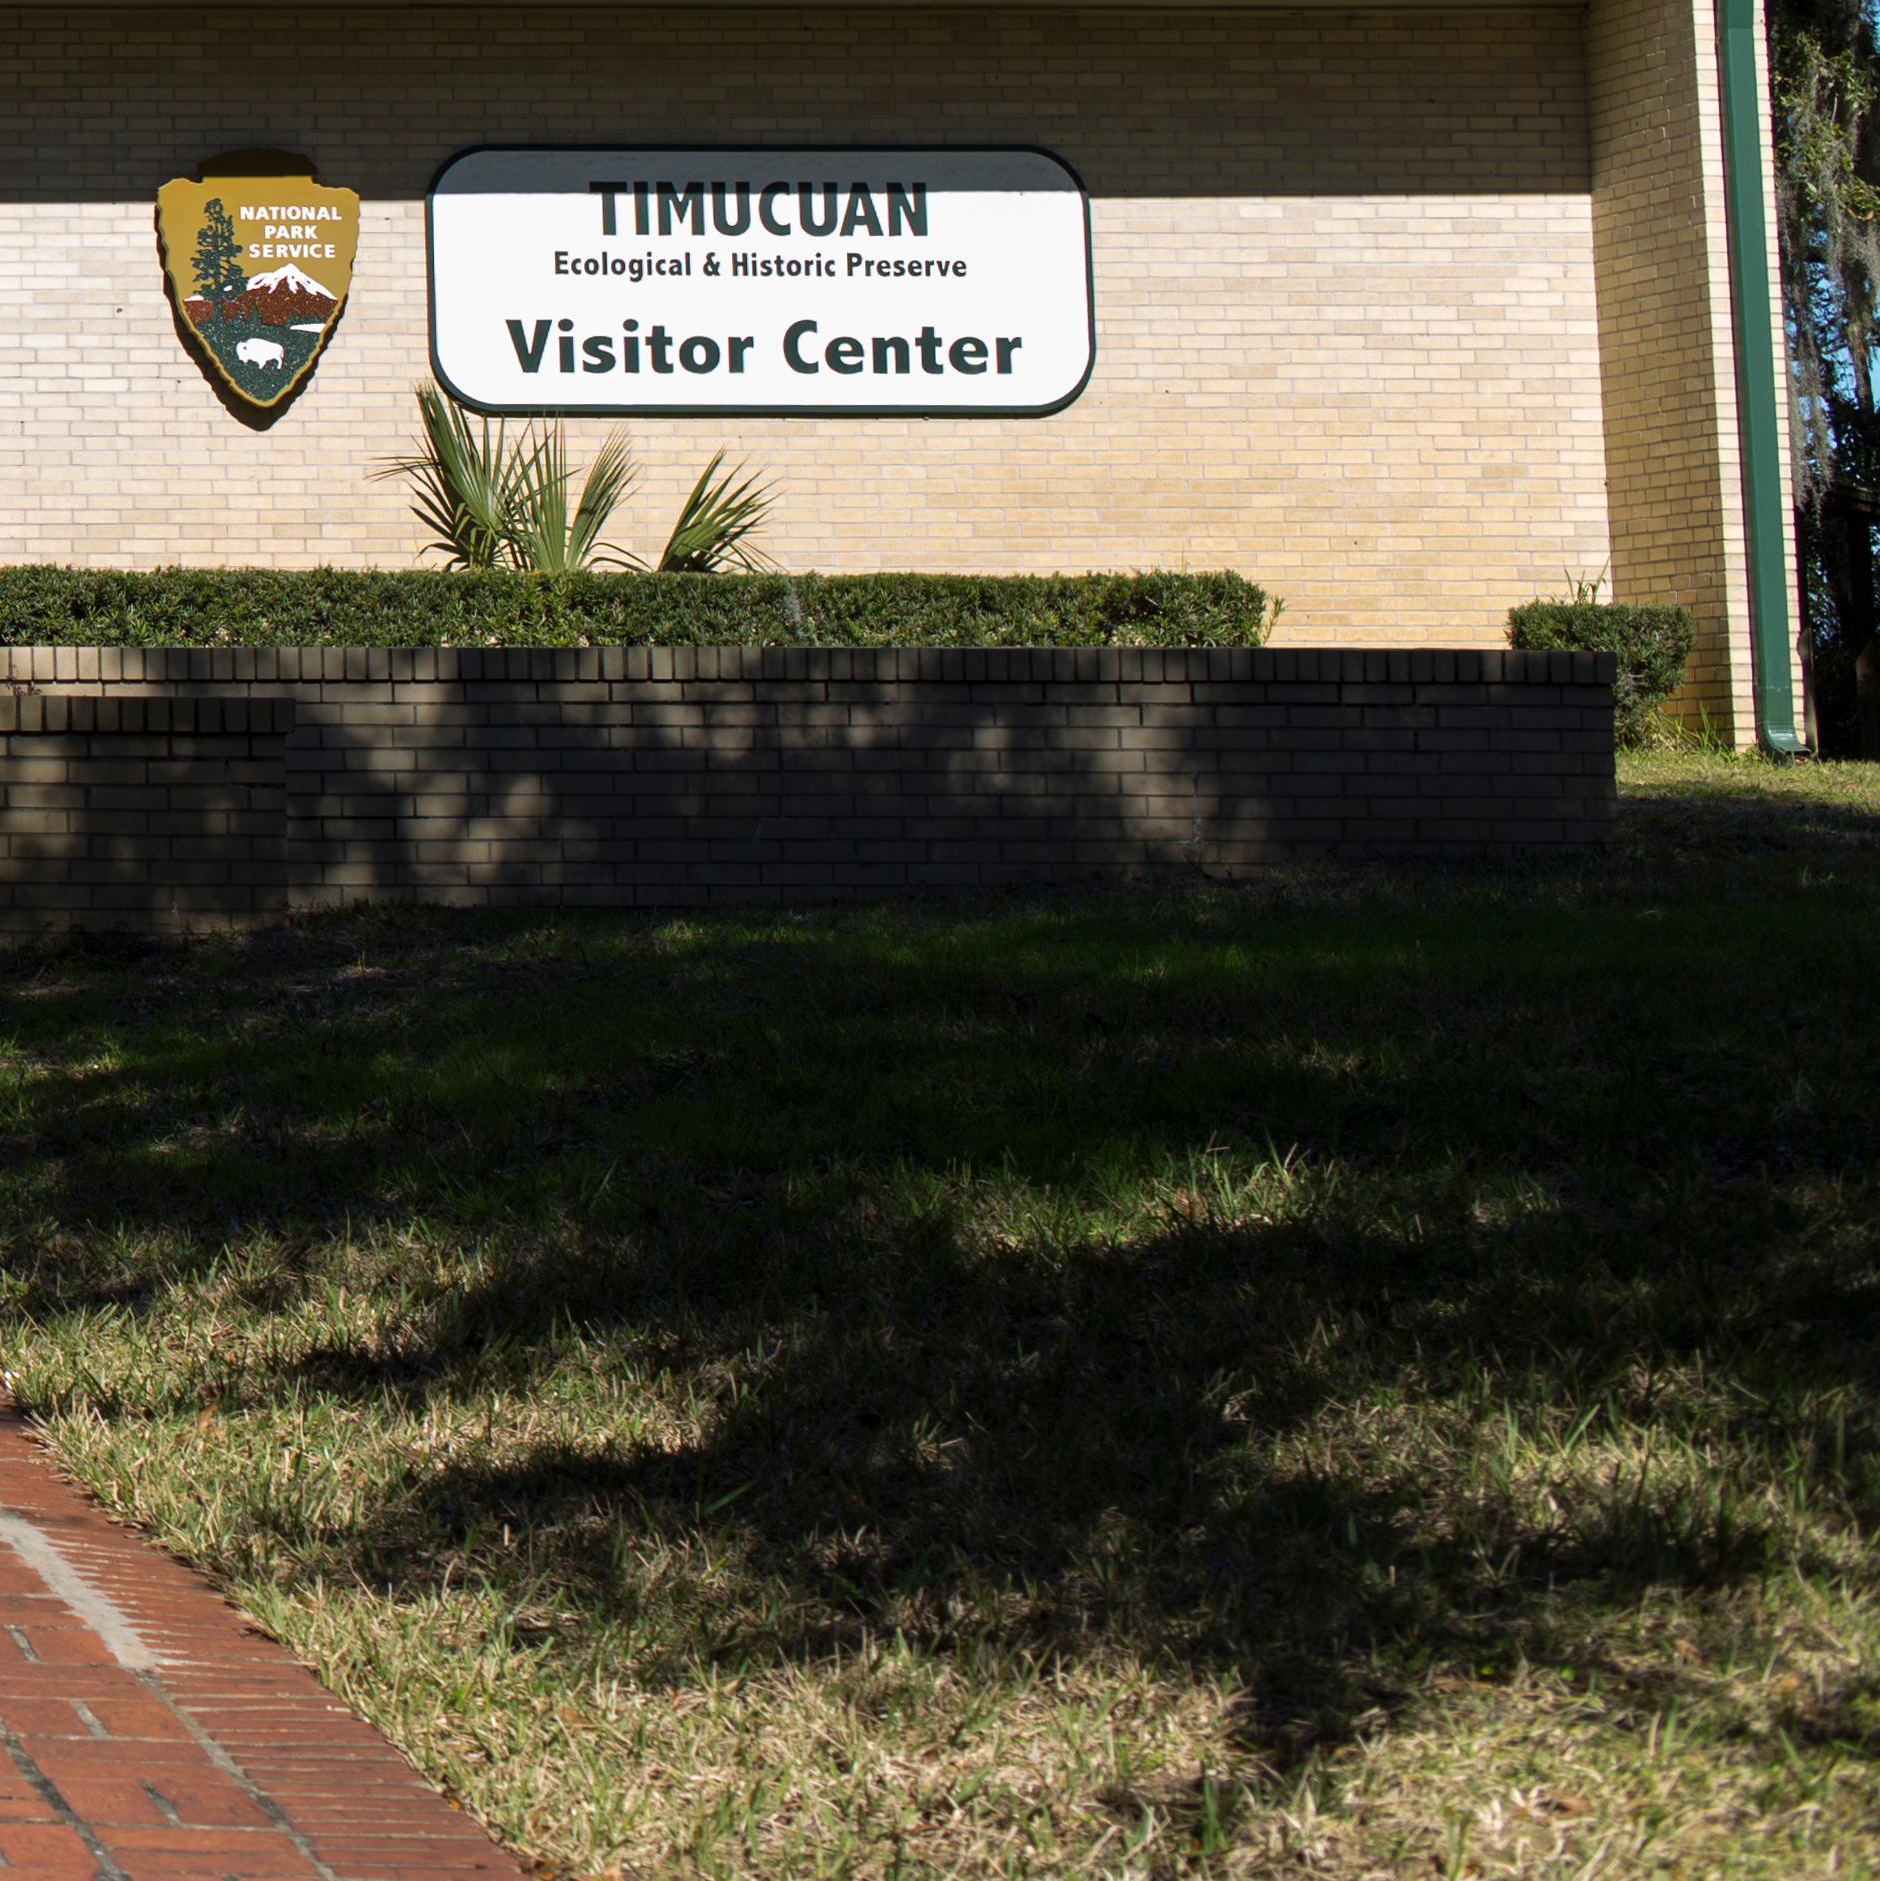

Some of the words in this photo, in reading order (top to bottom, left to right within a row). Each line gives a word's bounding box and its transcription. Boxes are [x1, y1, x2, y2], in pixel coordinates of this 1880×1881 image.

[240, 206, 342, 220] NATIONAL
[589, 180, 928, 236] TIMUCUAN
[264, 225, 318, 239] PARK
[249, 244, 336, 258] SERVICE
[555, 252, 690, 283] Ecological
[703, 252, 721, 277] &
[732, 252, 836, 277] Historic
[847, 252, 967, 278] Preserve
[506, 319, 754, 374] Visitor
[784, 319, 1022, 375] Center
